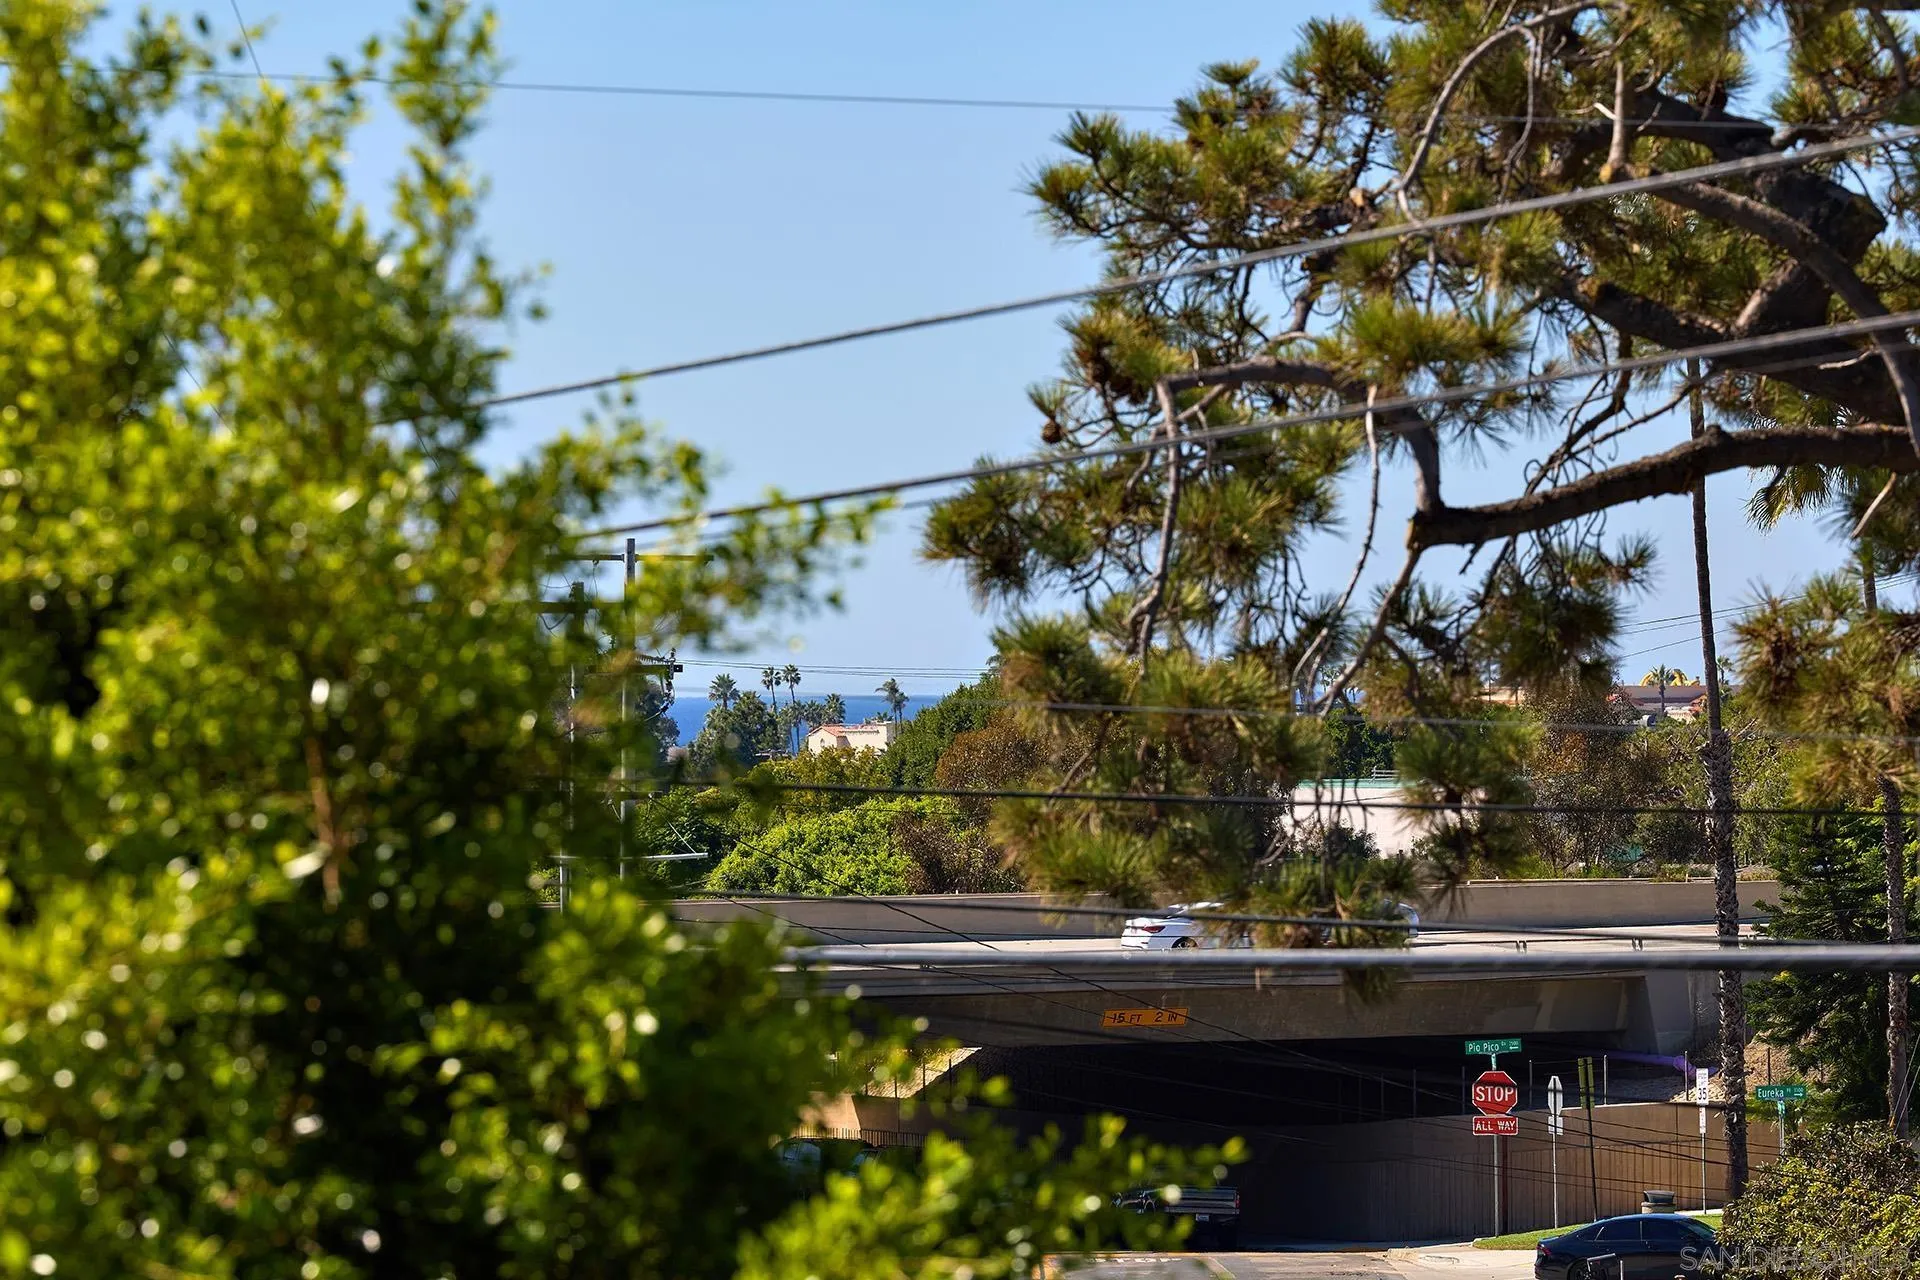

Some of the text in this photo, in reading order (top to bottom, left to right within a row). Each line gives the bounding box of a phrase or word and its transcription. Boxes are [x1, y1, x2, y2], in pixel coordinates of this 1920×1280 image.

[1111, 1011, 1178, 1024] 15 FT 2 IN
[1468, 1042, 1480, 1053] Pio
[1483, 1041, 1499, 1052] Pico
[1475, 1086, 1514, 1102] STOP
[1698, 1087, 1707, 1101] 35
[1757, 1088, 1784, 1098] Eureka
[1475, 1120, 1516, 1131] ALL WAY
